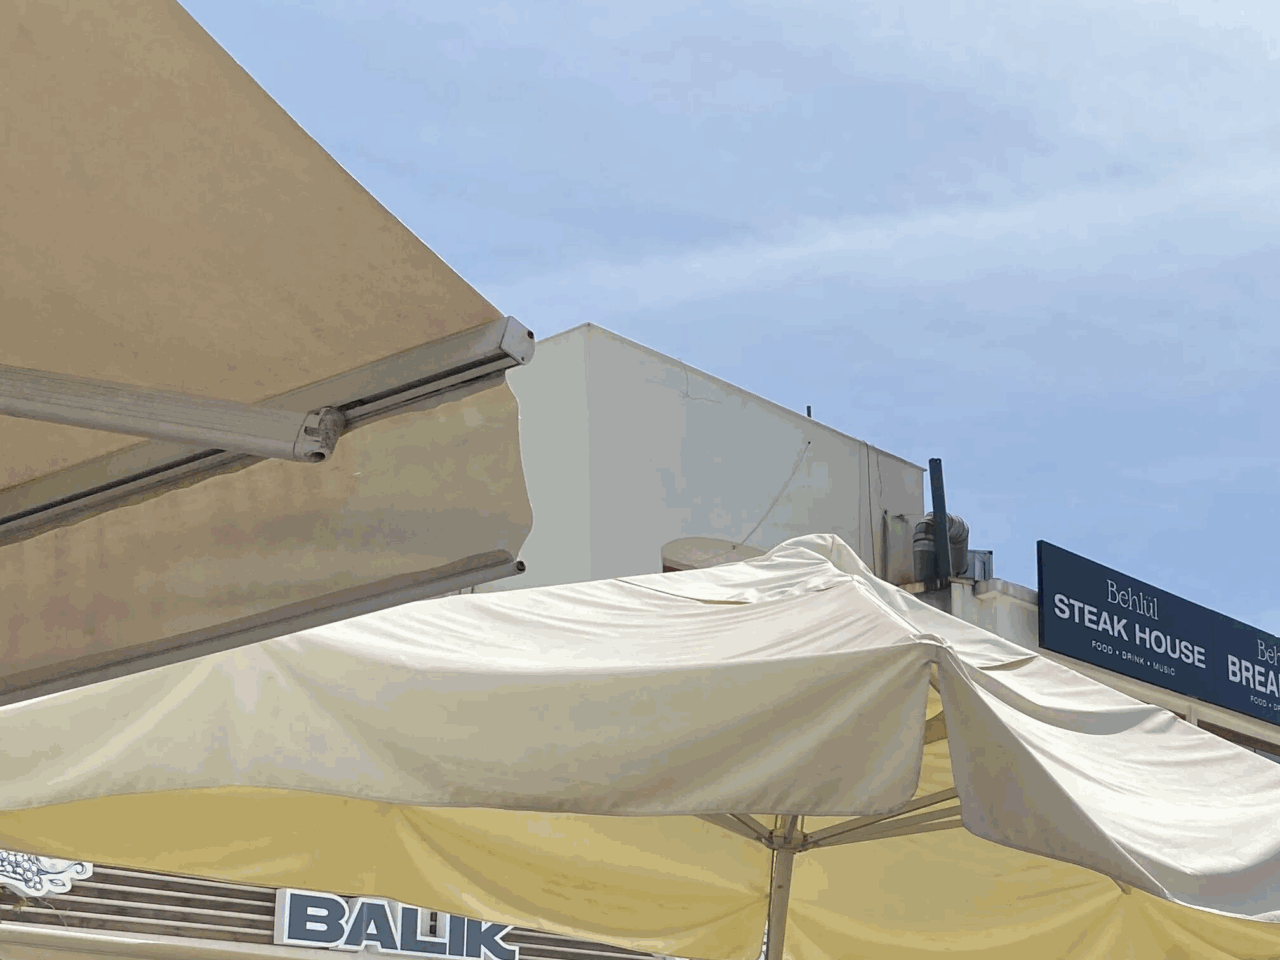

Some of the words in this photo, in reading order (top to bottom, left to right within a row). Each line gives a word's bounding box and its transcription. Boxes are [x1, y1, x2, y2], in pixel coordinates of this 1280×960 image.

[1106, 579, 1159, 620] Behlül
[1054, 593, 1129, 641] STEAK
[1135, 623, 1206, 669] HOUSE
[1091, 640, 1113, 655] FOOD
[1121, 651, 1145, 665] DRINK
[1153, 662, 1176, 676] MUSIC
[1250, 695, 1267, 707] FOOD
